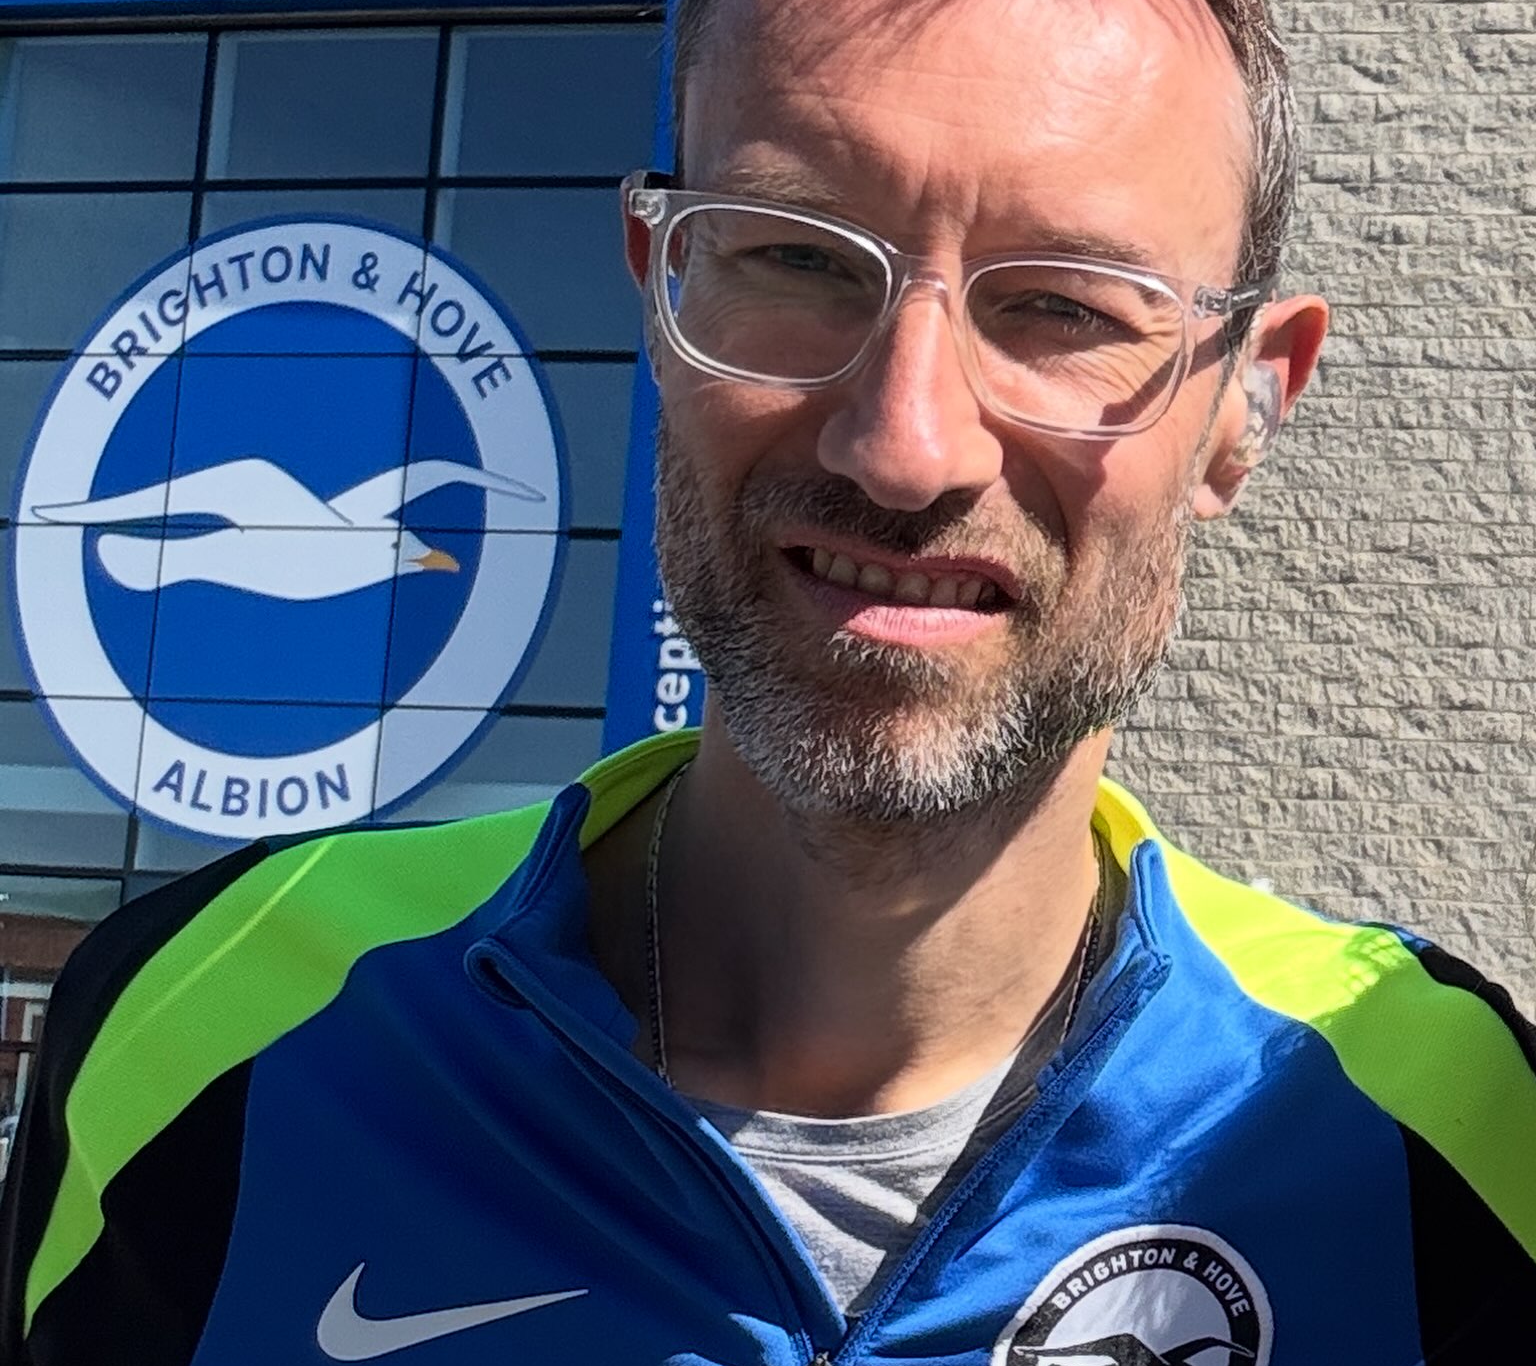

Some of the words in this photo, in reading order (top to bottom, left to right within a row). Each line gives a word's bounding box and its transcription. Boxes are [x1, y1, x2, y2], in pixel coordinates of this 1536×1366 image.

[86, 243, 331, 401] BRIGHTON
[353, 251, 381, 291] &
[398, 271, 511, 401] HOVE
[153, 759, 352, 819] ALBION
[1051, 1247, 1176, 1311] BRIGHTON
[1183, 1251, 1199, 1270] &
[1203, 1261, 1250, 1317] HOVE
